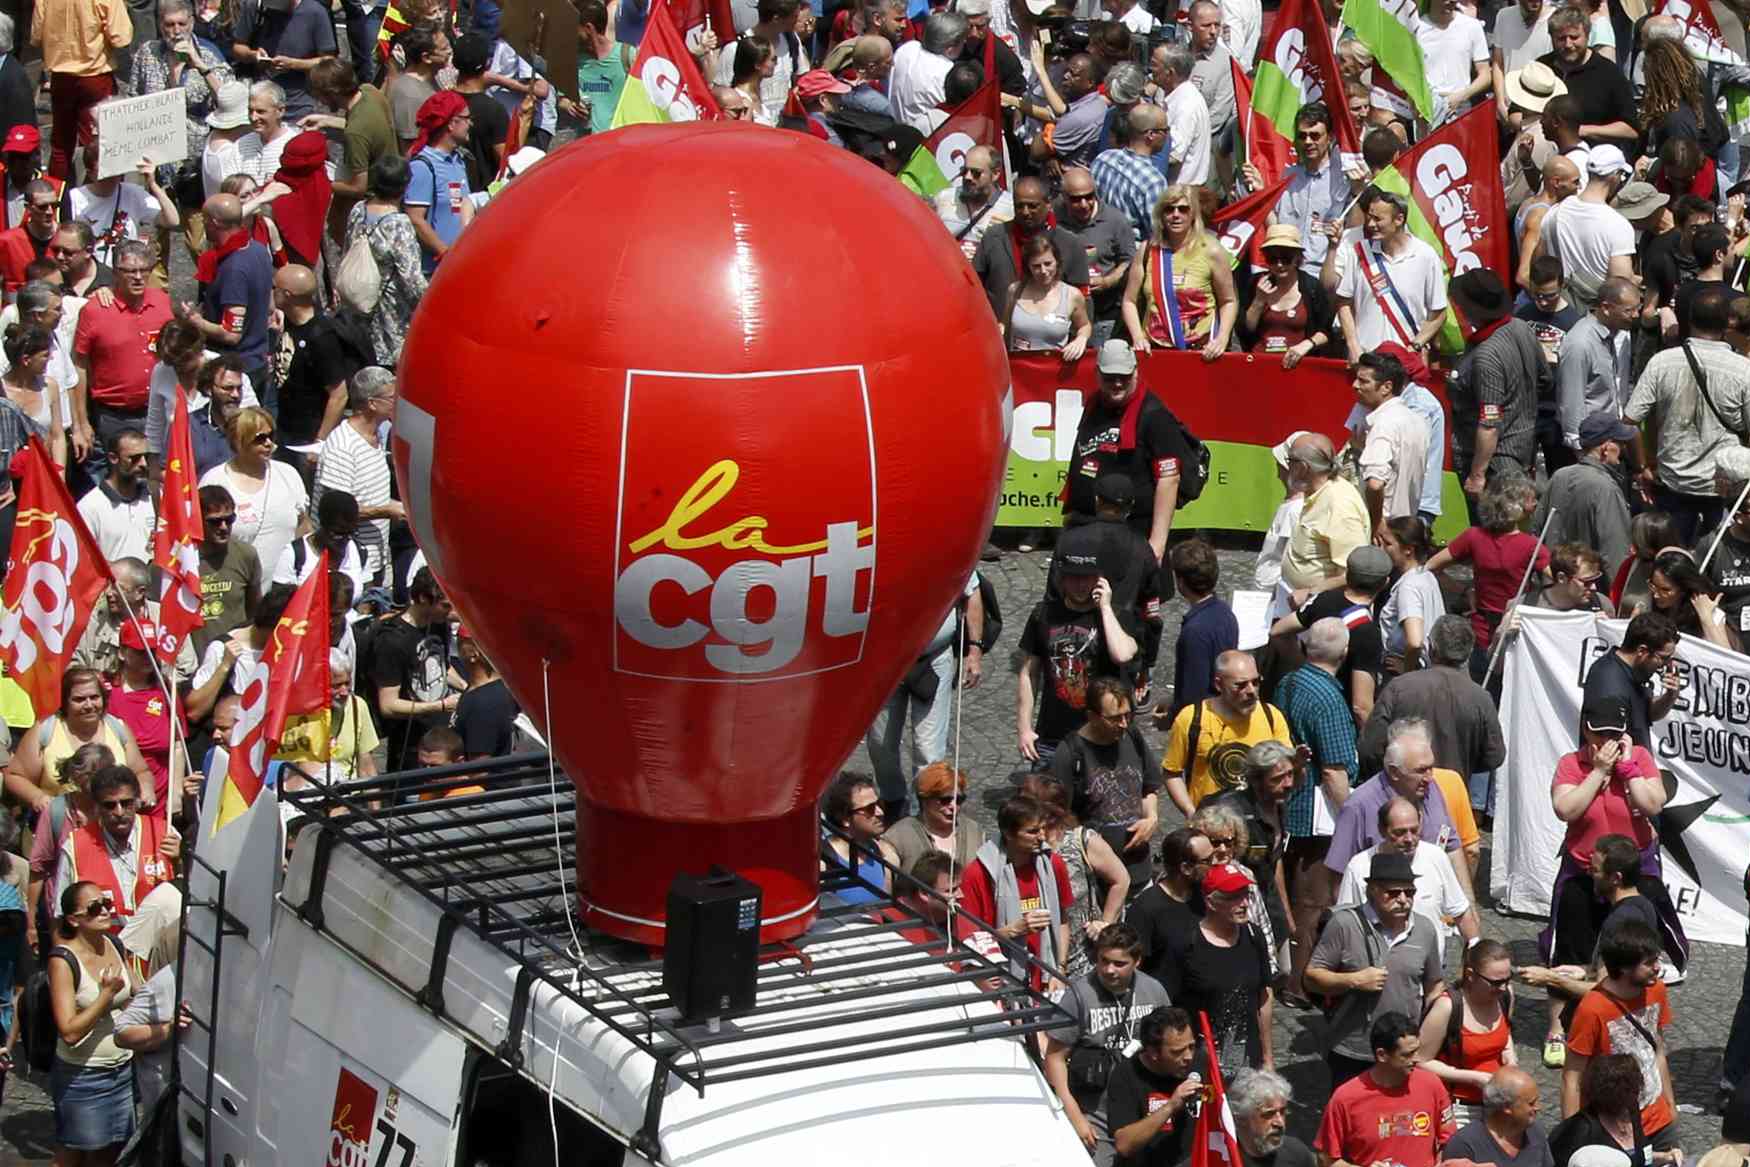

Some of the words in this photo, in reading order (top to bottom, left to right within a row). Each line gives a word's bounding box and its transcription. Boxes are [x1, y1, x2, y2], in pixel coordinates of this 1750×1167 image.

[629, 459, 875, 554] la
[615, 520, 873, 674] cgt
[1089, 1006, 1117, 1034] BEST
